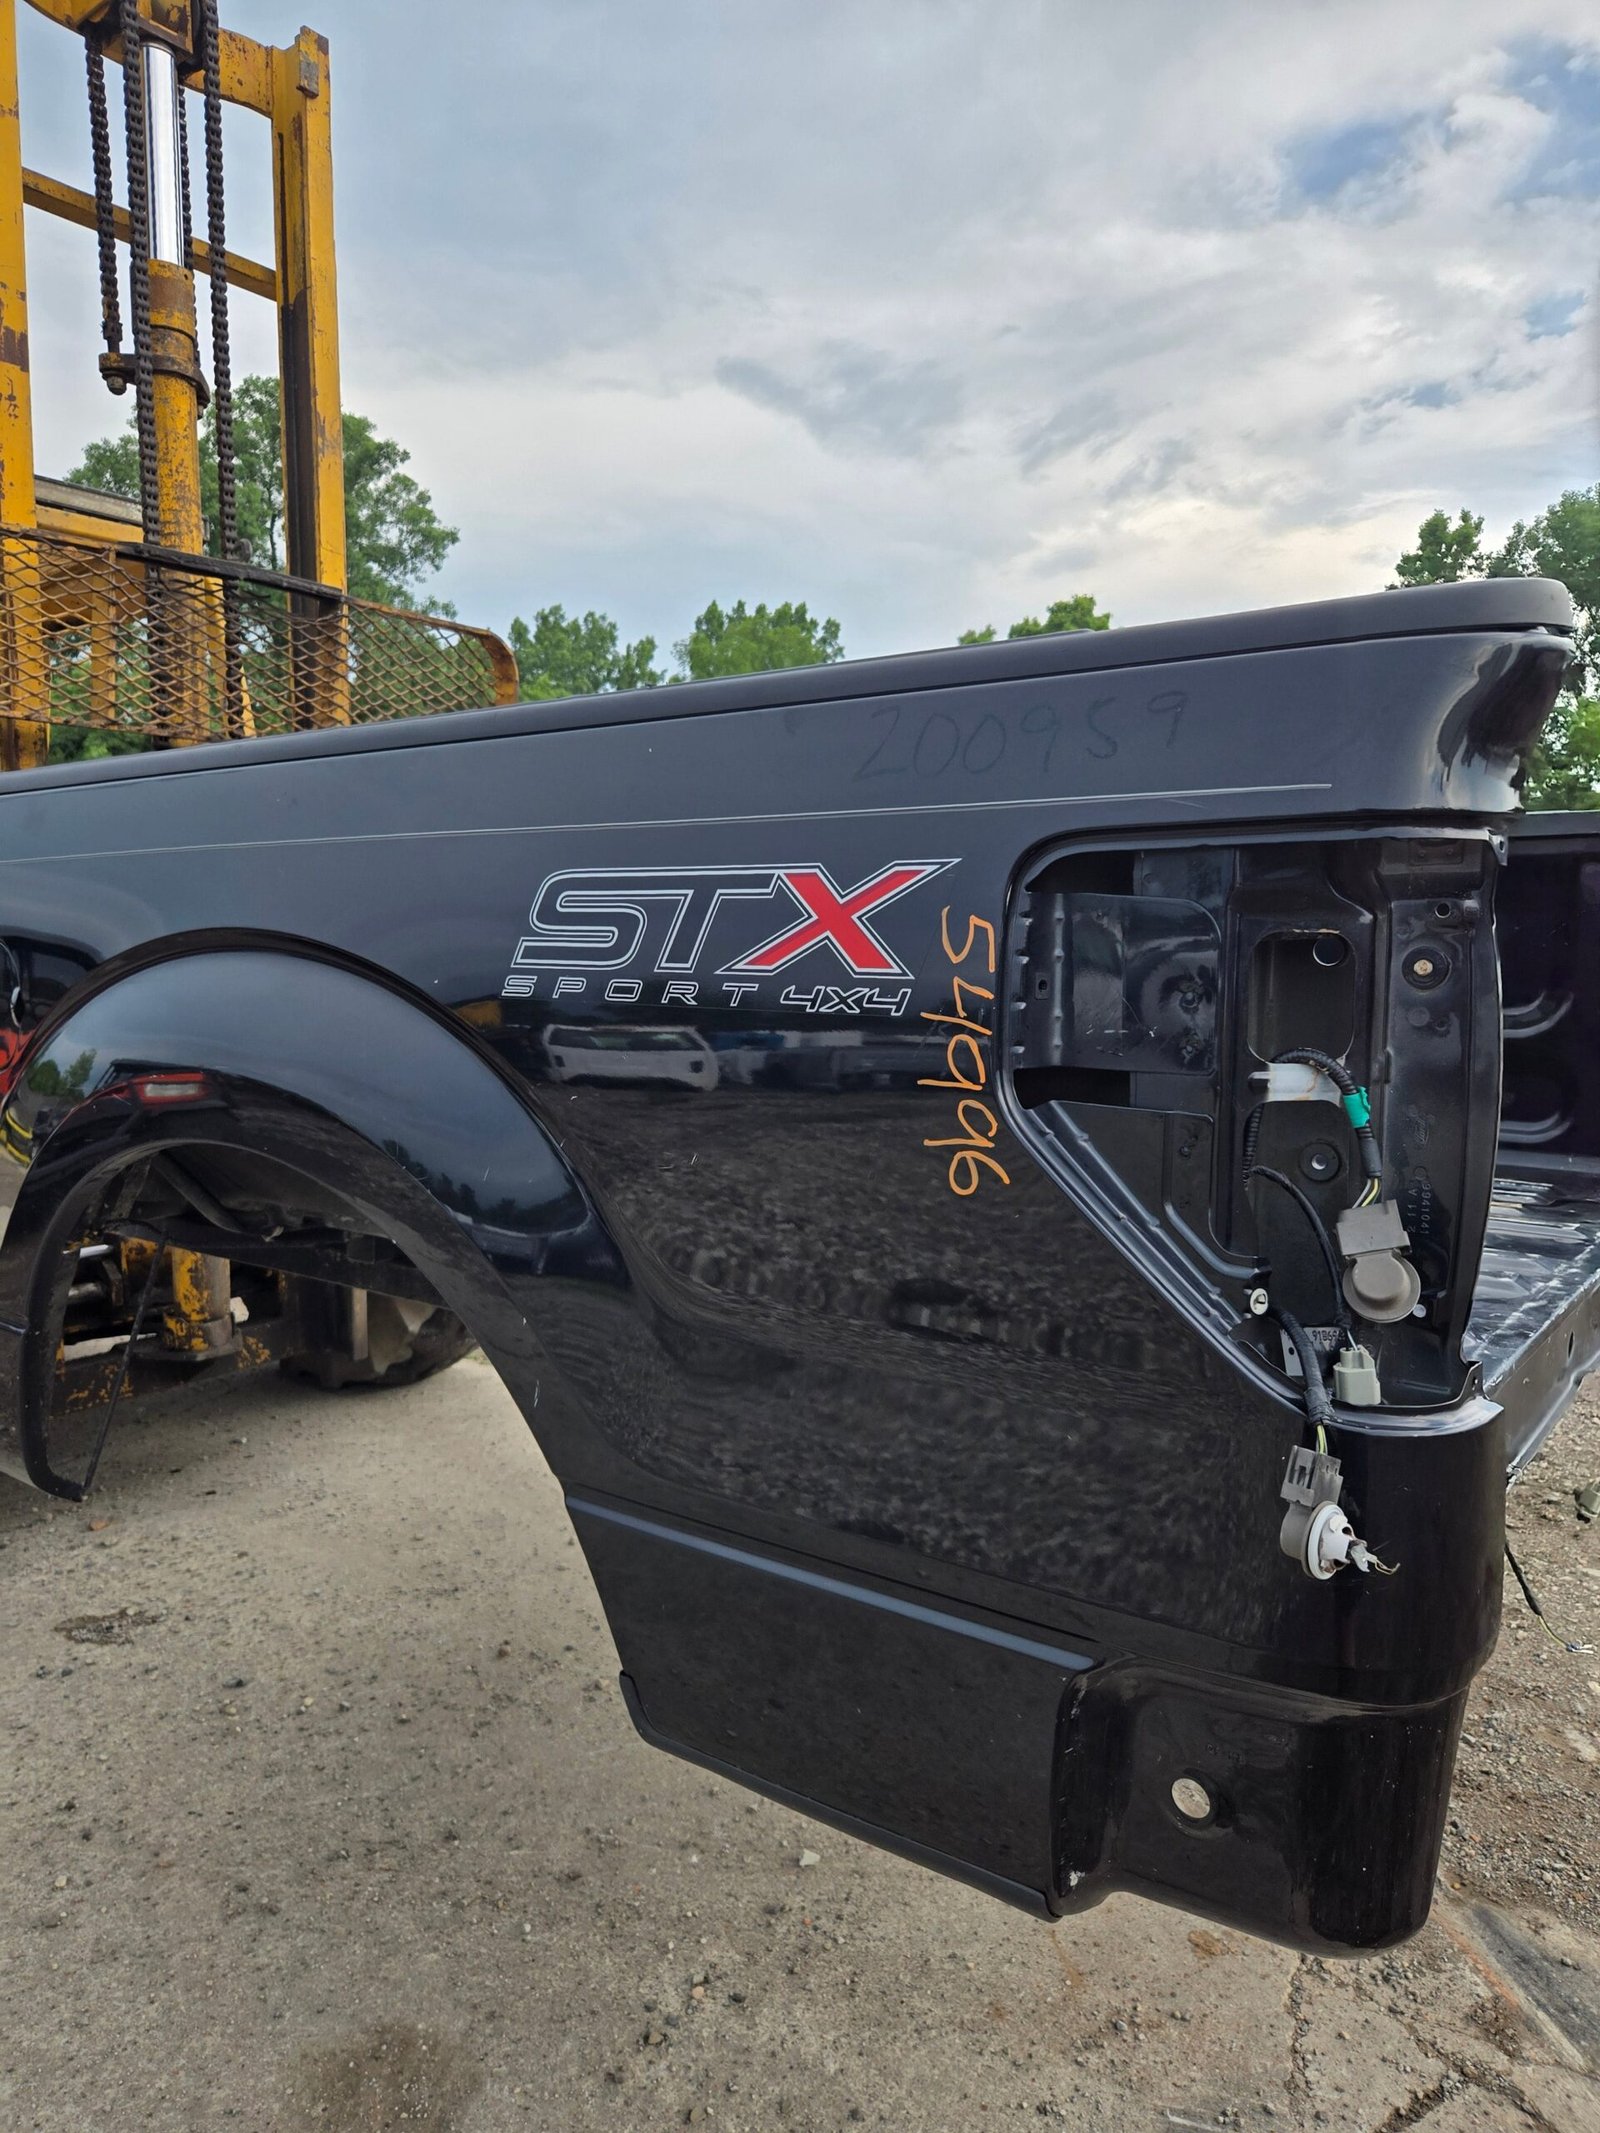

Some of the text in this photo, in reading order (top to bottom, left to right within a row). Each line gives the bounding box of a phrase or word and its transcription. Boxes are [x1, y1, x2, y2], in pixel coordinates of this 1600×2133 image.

[510, 857, 962, 979] STX
[500, 974, 760, 1005] SPORT
[916, 904, 1011, 1196] 54996
